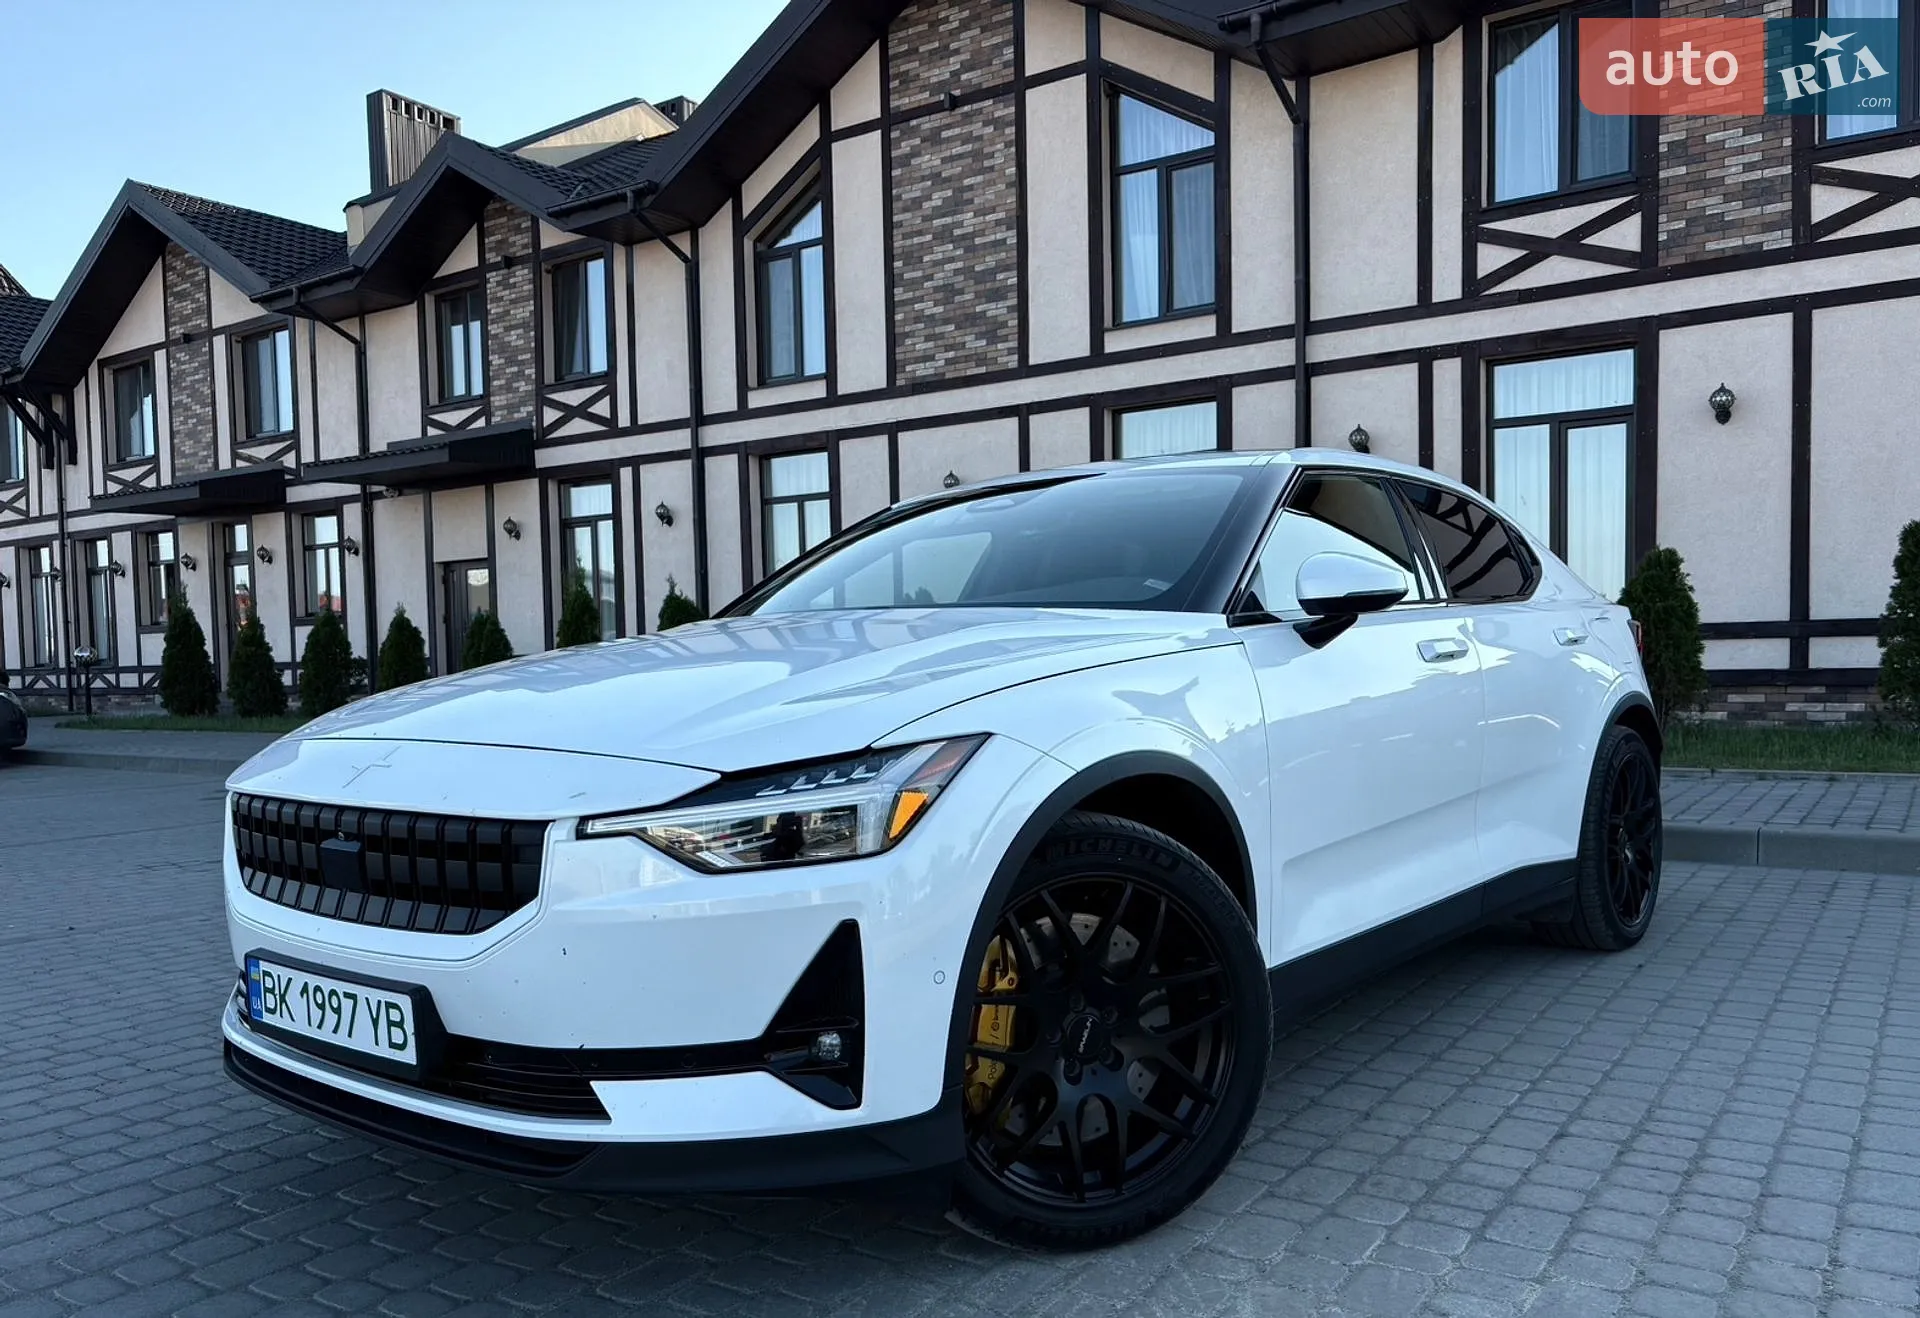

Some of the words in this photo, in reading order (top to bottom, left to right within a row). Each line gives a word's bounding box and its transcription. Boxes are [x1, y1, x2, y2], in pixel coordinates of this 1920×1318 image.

[252, 996, 263, 1010] UA
[261, 969, 296, 1023] BK
[299, 980, 358, 1039] 1997
[364, 996, 408, 1051] YB
